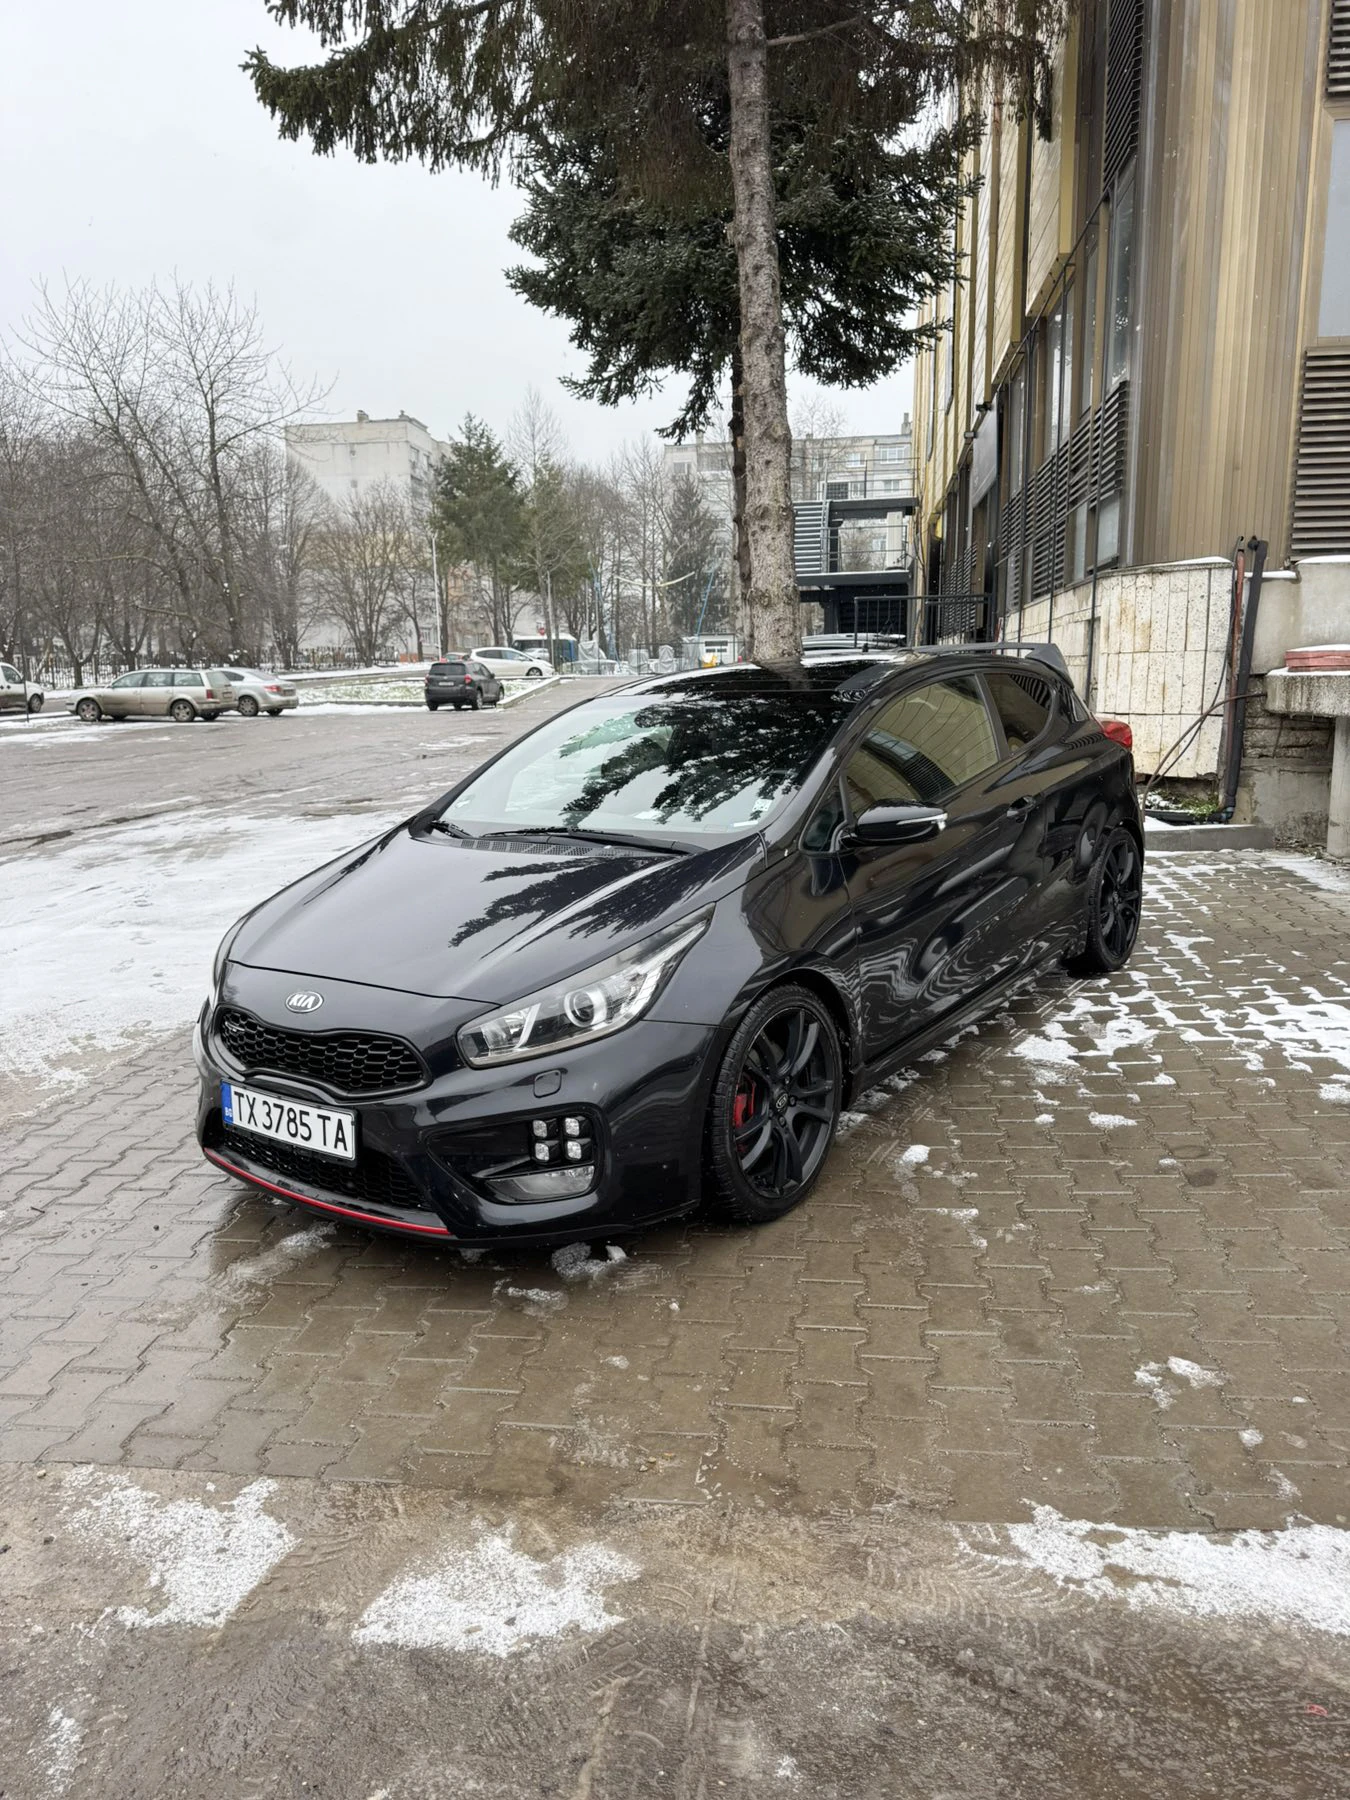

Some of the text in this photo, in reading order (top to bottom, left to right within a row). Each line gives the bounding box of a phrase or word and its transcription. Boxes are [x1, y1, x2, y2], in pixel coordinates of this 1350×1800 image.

[288, 993, 316, 1009] KIA
[234, 1092, 348, 1152] TX 3785 TA
